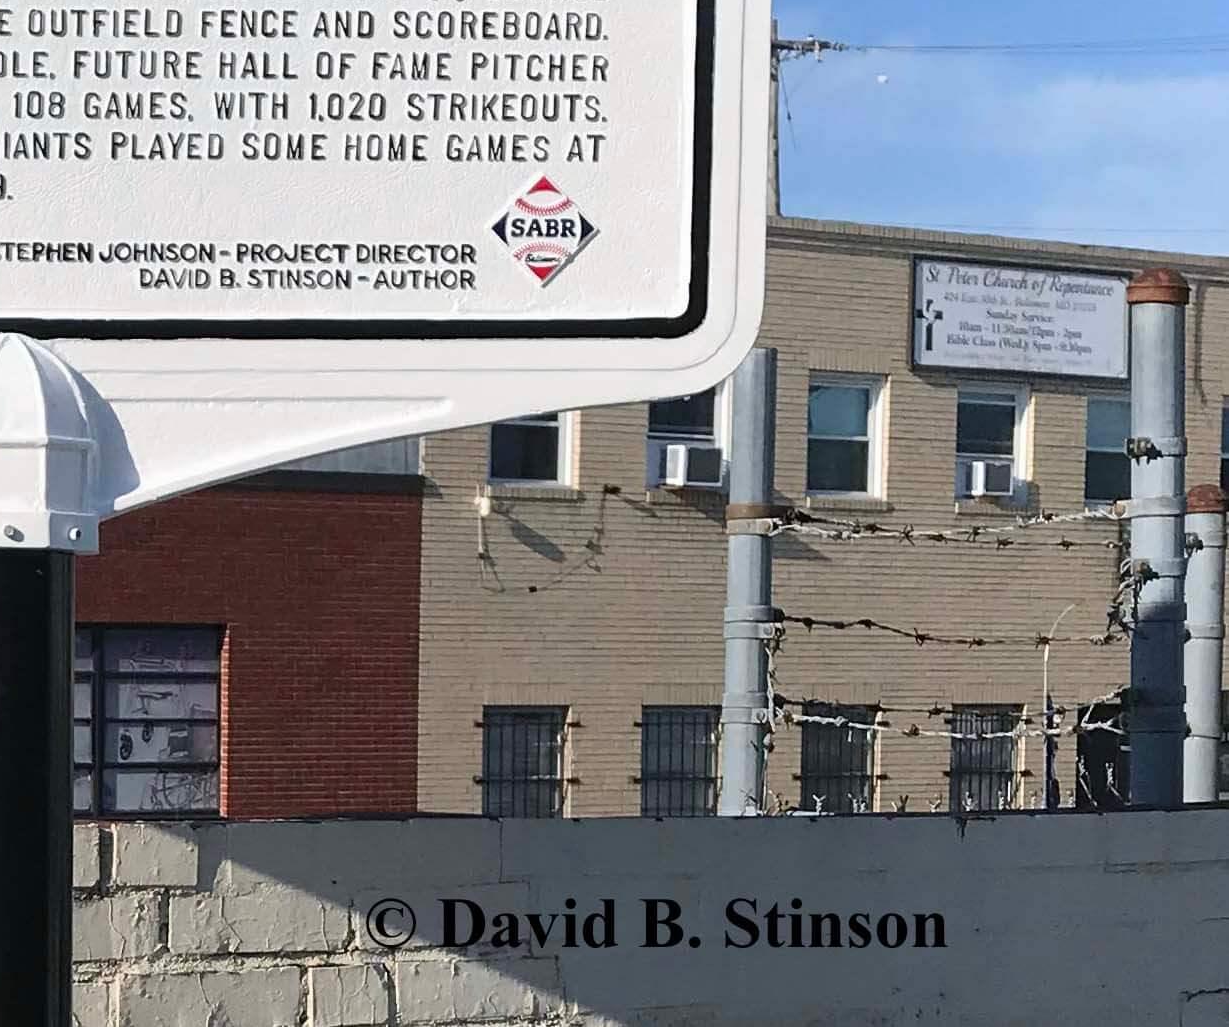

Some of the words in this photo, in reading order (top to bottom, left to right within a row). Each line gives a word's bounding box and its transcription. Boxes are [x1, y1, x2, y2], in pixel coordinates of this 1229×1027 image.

[73, 50, 203, 80] FUTURE
[218, 51, 299, 80] HALL
[315, 51, 357, 81] OF
[371, 51, 452, 82] FAME
[470, 51, 609, 83] PITCHER
[110, 131, 225, 161] PLAYED
[241, 132, 328, 162] SOME
[344, 133, 429, 162] HOME
[445, 133, 551, 163] GAMES
[566, 133, 607, 163] AT
[510, 218, 576, 238] SABR
[98, 242, 216, 264] JOHNSON
[236, 242, 351, 265] PROJECT
[355, 243, 477, 265] DIRECTOR
[139, 267, 212, 290] DAVID
[219, 267, 242, 290] B.
[247, 268, 352, 290] STINSON
[372, 269, 477, 291] AUTHOR
[983, 269, 1028, 289] Church
[1031, 276, 1047, 296] of
